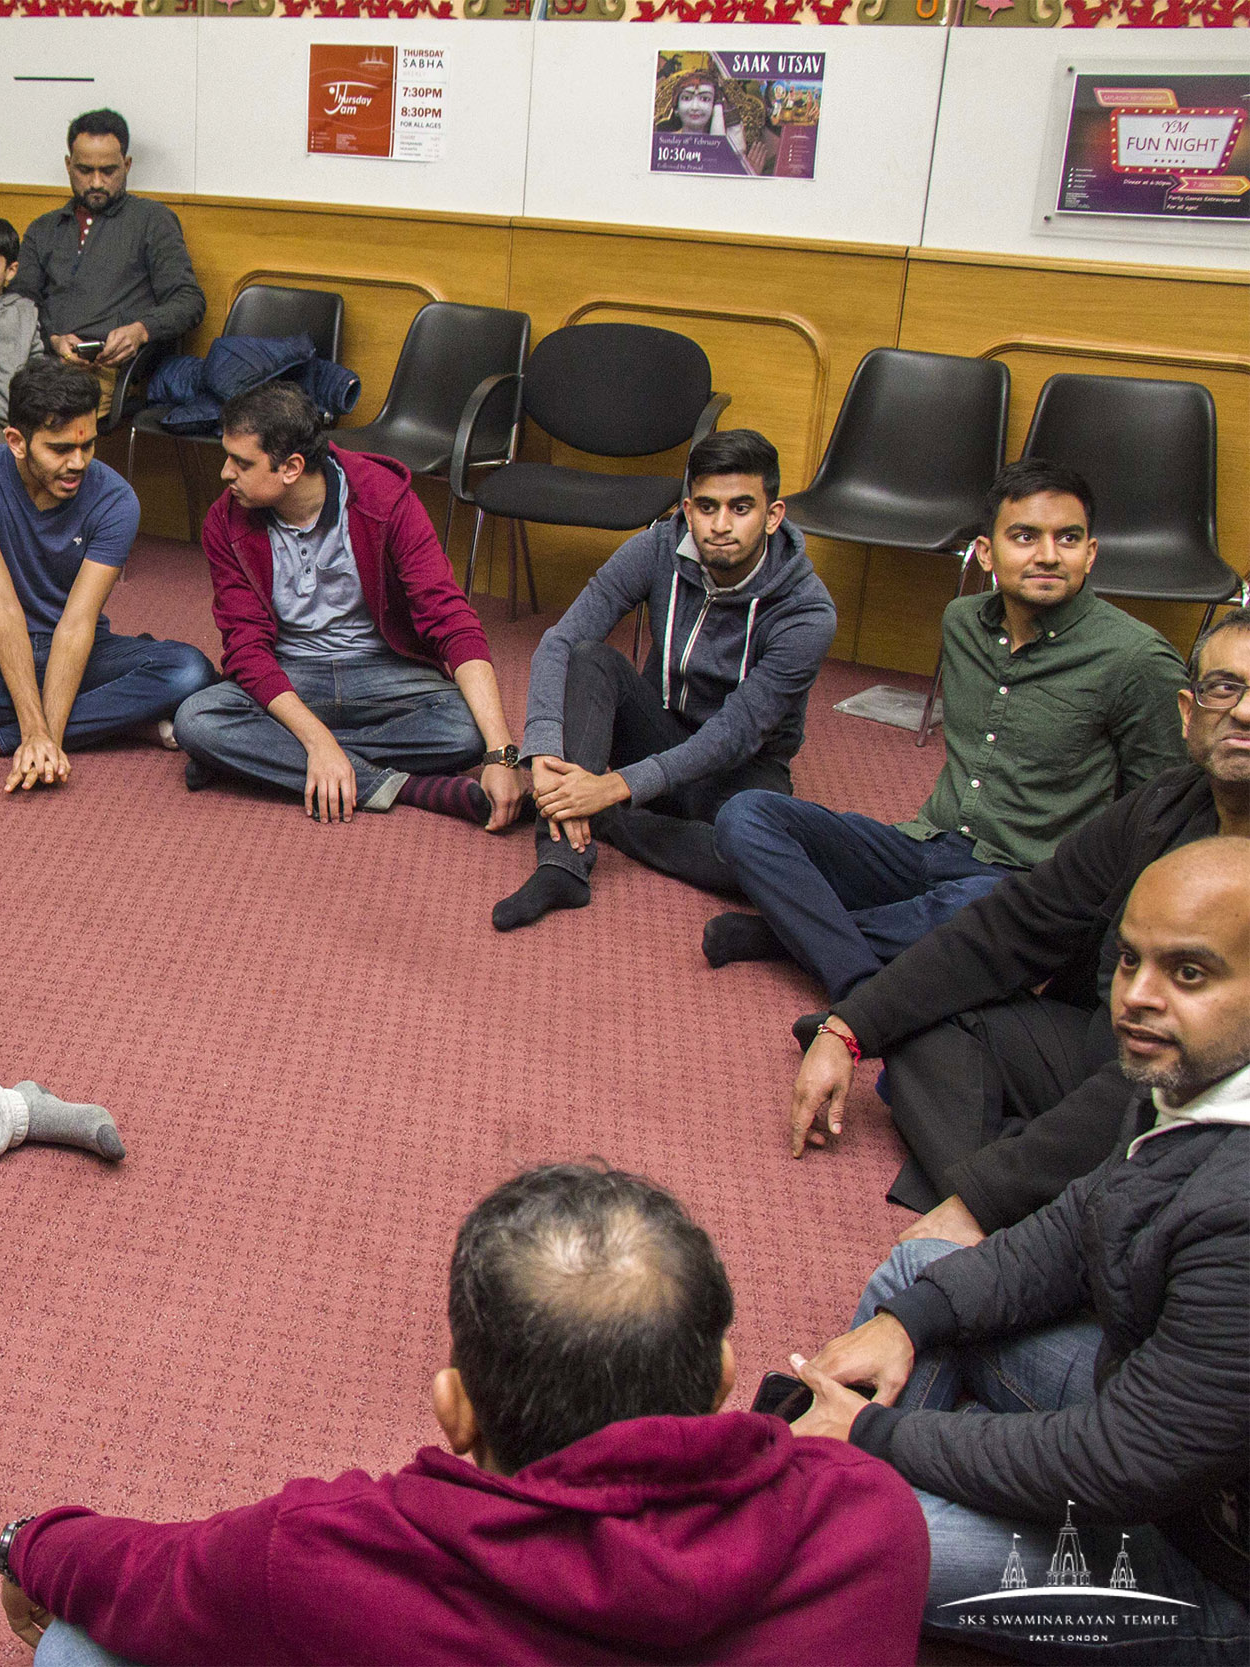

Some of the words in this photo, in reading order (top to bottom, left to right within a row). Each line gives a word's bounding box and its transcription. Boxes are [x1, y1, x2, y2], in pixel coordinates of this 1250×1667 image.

[403, 49, 444, 58] THURSDAY
[403, 58, 444, 69] SABHA
[732, 54, 770, 73] SAAK
[777, 55, 822, 74] UTSAV
[402, 87, 443, 98] 7:30PM
[401, 106, 442, 118] 8:30PM
[1162, 120, 1190, 134] YM
[659, 136, 682, 147] Sunday
[694, 136, 721, 148] February
[1126, 137, 1160, 151] FUN
[1165, 138, 1220, 152] NIGHT
[658, 146, 702, 162] 10:30am
